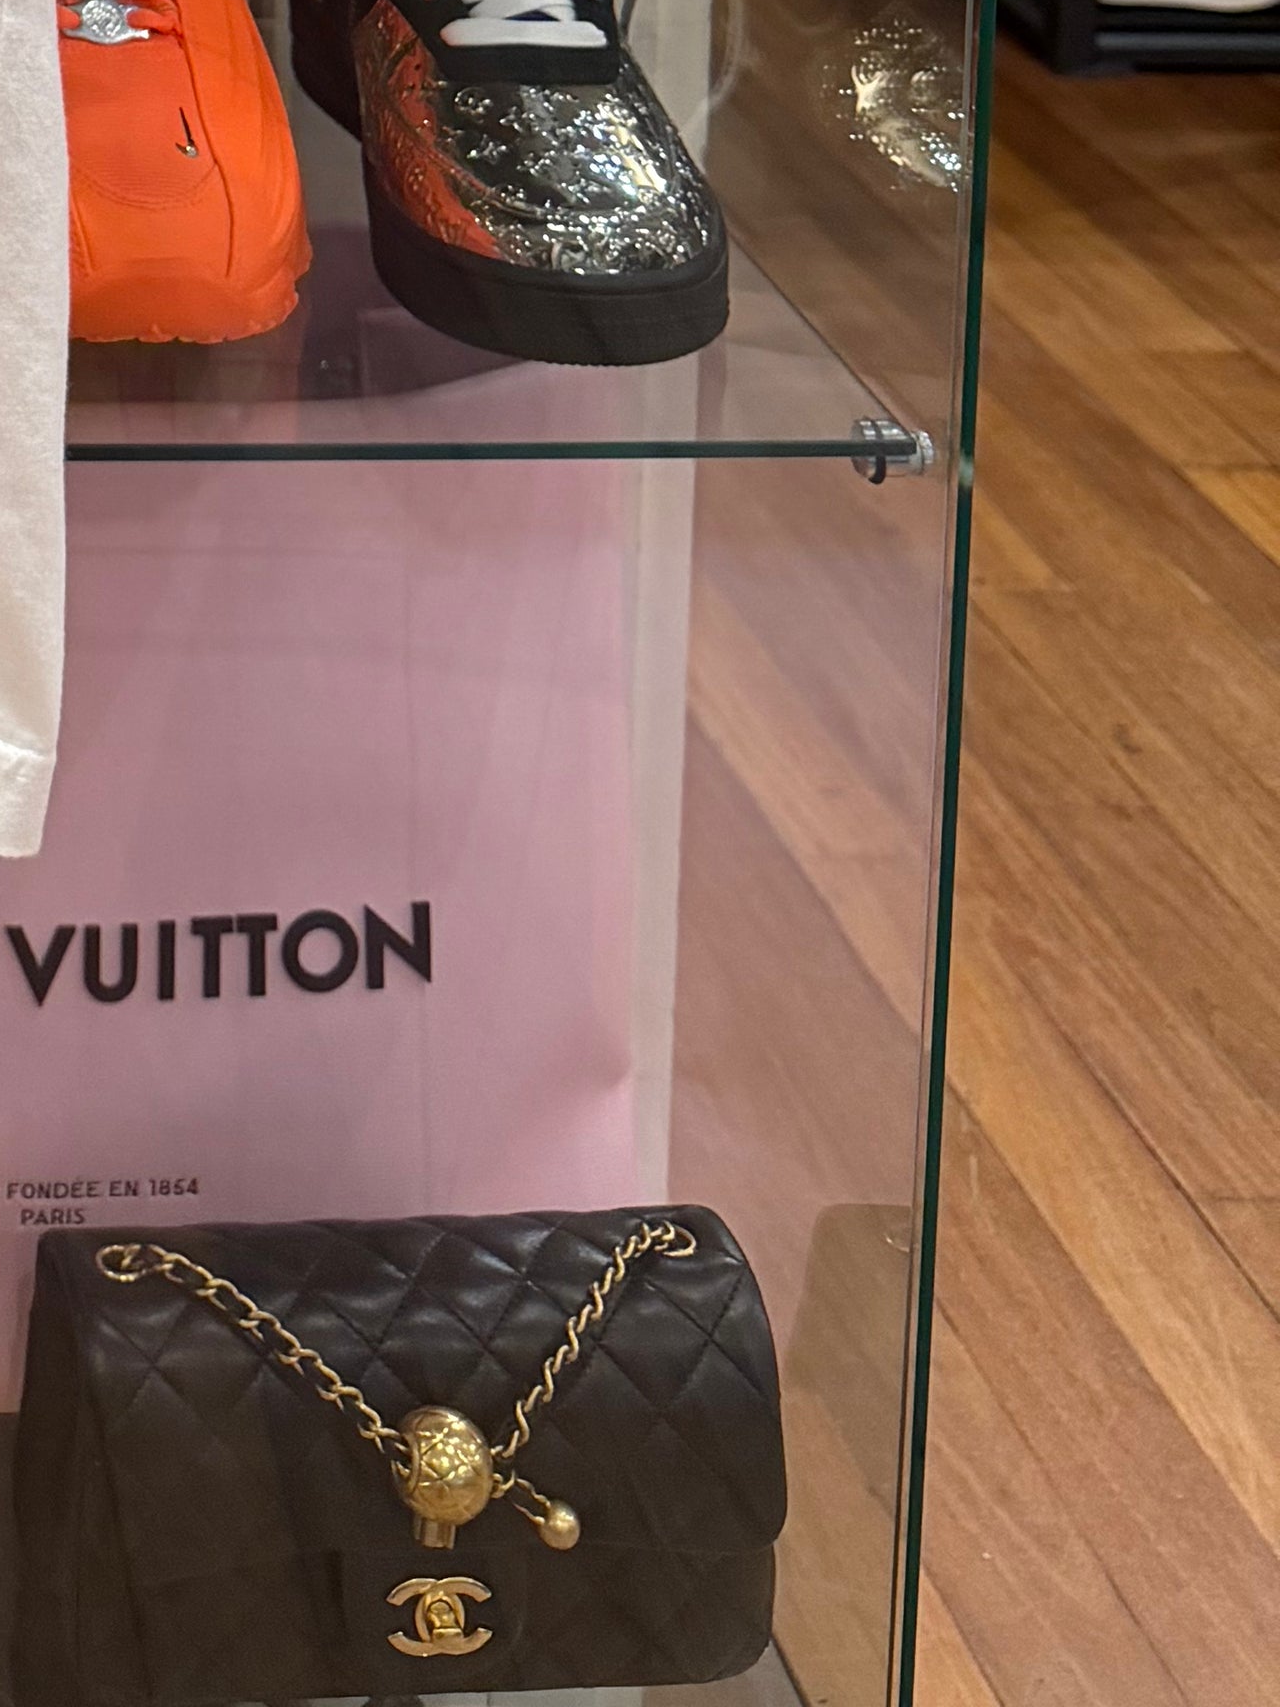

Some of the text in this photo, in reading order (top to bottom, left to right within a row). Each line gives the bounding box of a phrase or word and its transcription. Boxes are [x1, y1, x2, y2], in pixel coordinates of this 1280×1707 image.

[4, 899, 432, 1008] VUITTON
[109, 1179, 139, 1198] EN
[20, 1207, 86, 1226] PARIS
